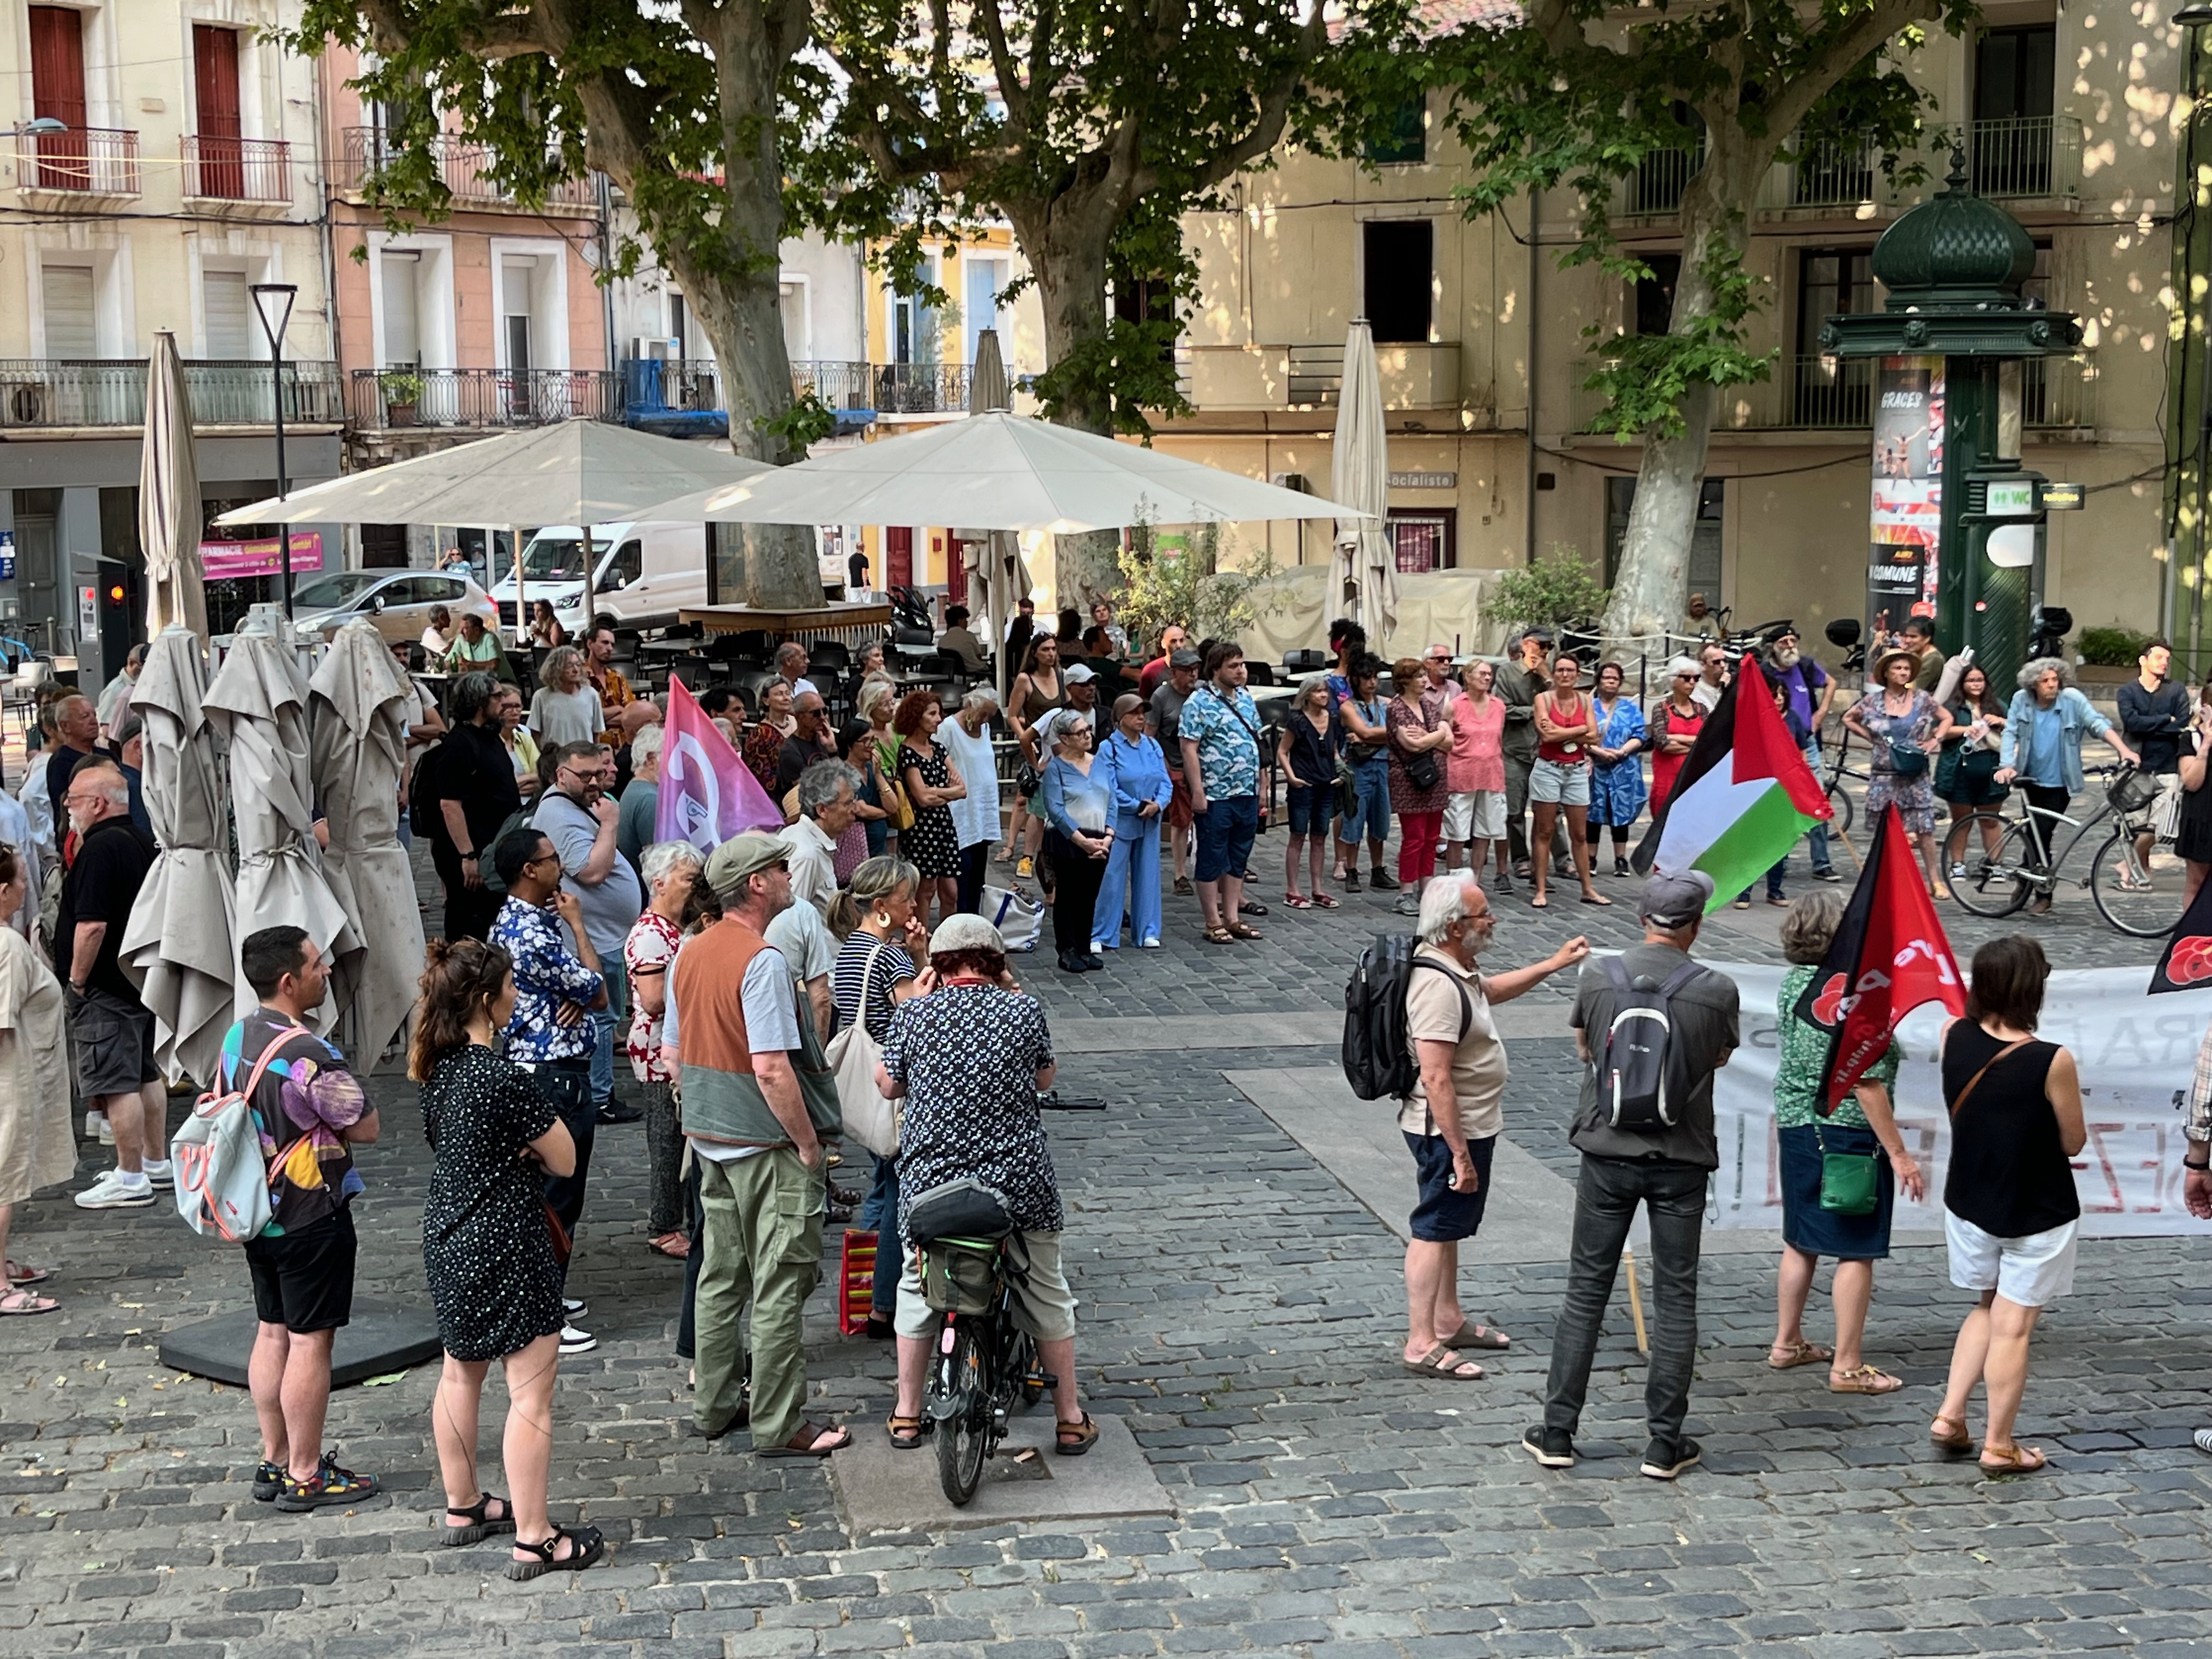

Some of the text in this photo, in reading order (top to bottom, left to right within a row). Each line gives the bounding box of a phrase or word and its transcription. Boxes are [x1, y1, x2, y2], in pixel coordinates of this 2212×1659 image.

[1881, 392, 1923, 408] GRACES
[2012, 491, 2030, 504] WC
[1873, 565, 1918, 583] COMUNE
